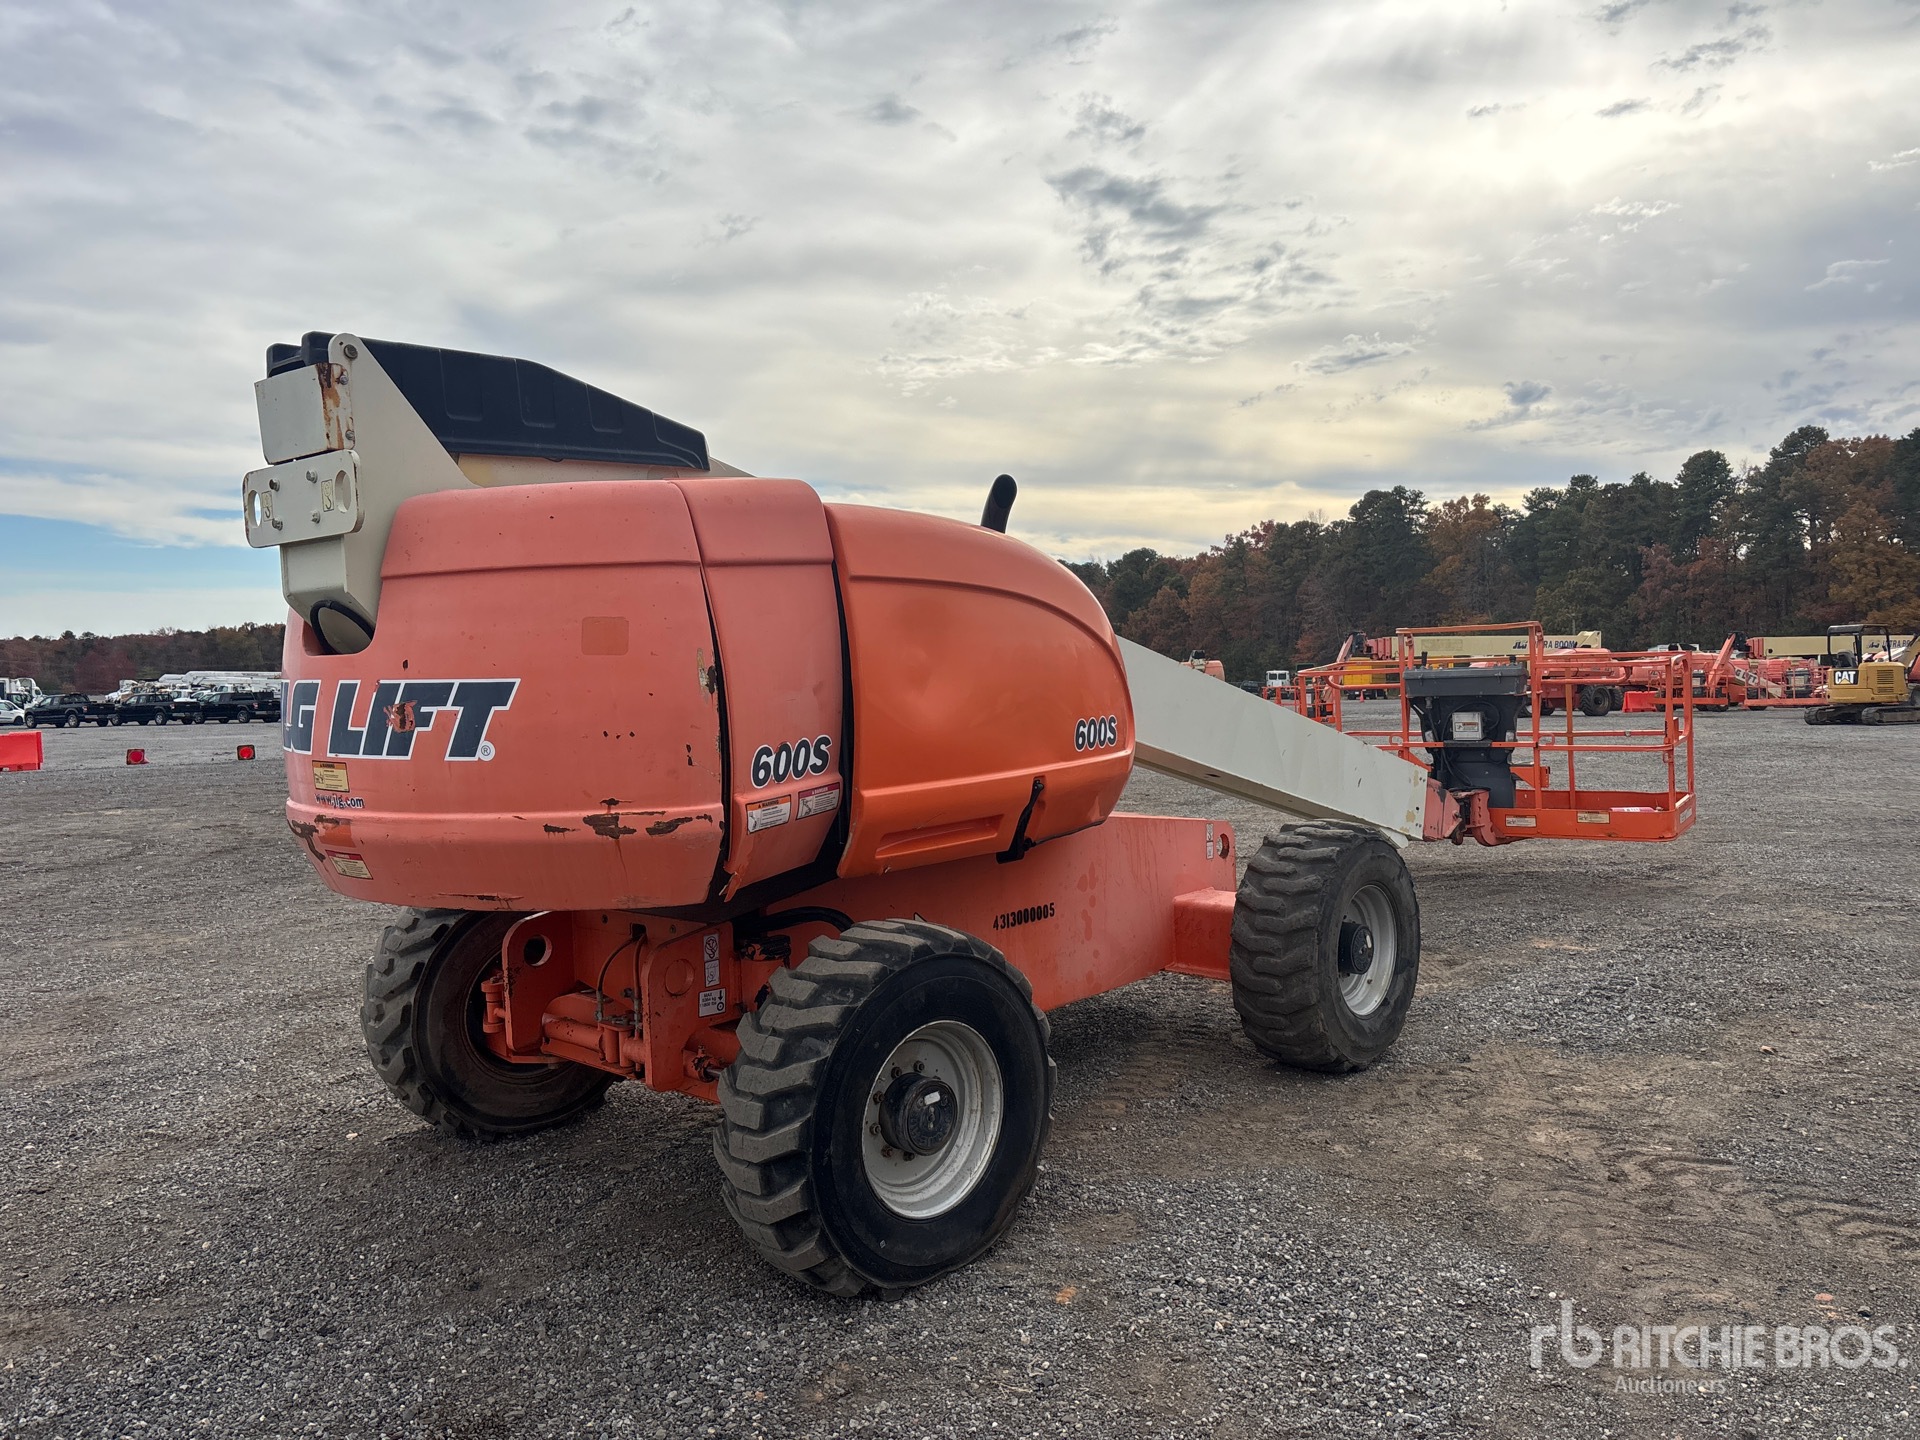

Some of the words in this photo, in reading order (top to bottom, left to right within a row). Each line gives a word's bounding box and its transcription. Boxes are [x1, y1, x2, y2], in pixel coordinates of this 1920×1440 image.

[1835, 671, 1856, 685] CAT
[327, 678, 521, 761] LIFT
[1074, 714, 1117, 752] 600S
[751, 734, 832, 789] 600S
[314, 793, 365, 809] www.jlg.com
[993, 902, 1055, 930] 4313000005
